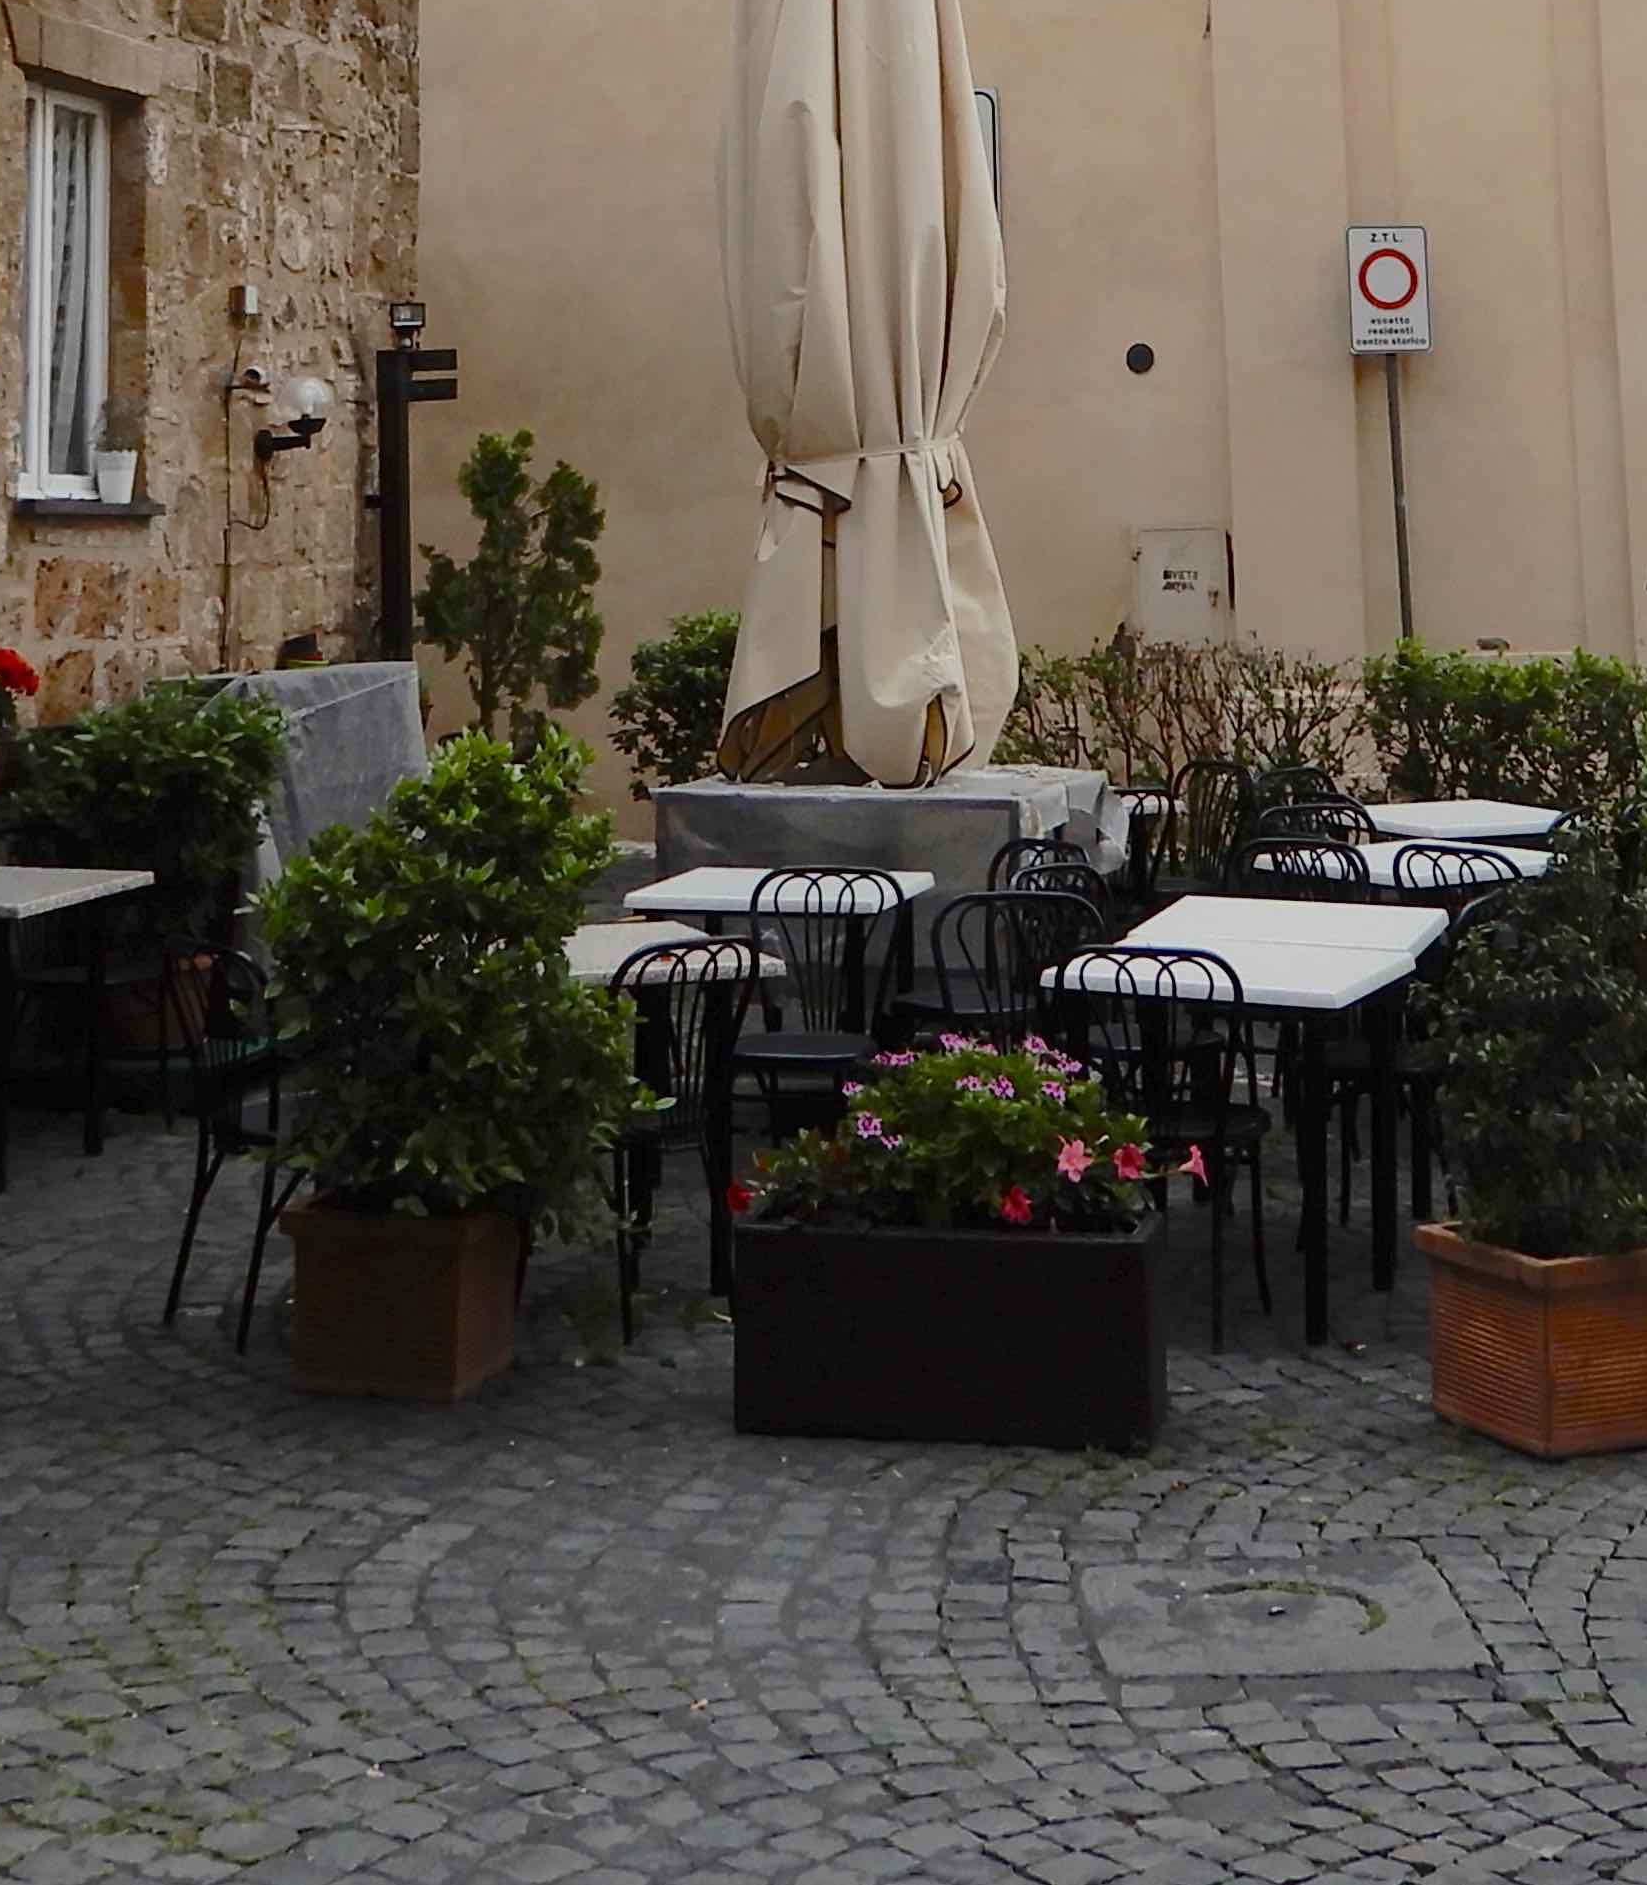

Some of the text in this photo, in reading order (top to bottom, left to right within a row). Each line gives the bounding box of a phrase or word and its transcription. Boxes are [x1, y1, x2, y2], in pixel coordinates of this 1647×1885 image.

[1370, 316, 1411, 325] eccetto
[1367, 326, 1414, 335] residenti
[1355, 337, 1427, 346] centro storico
